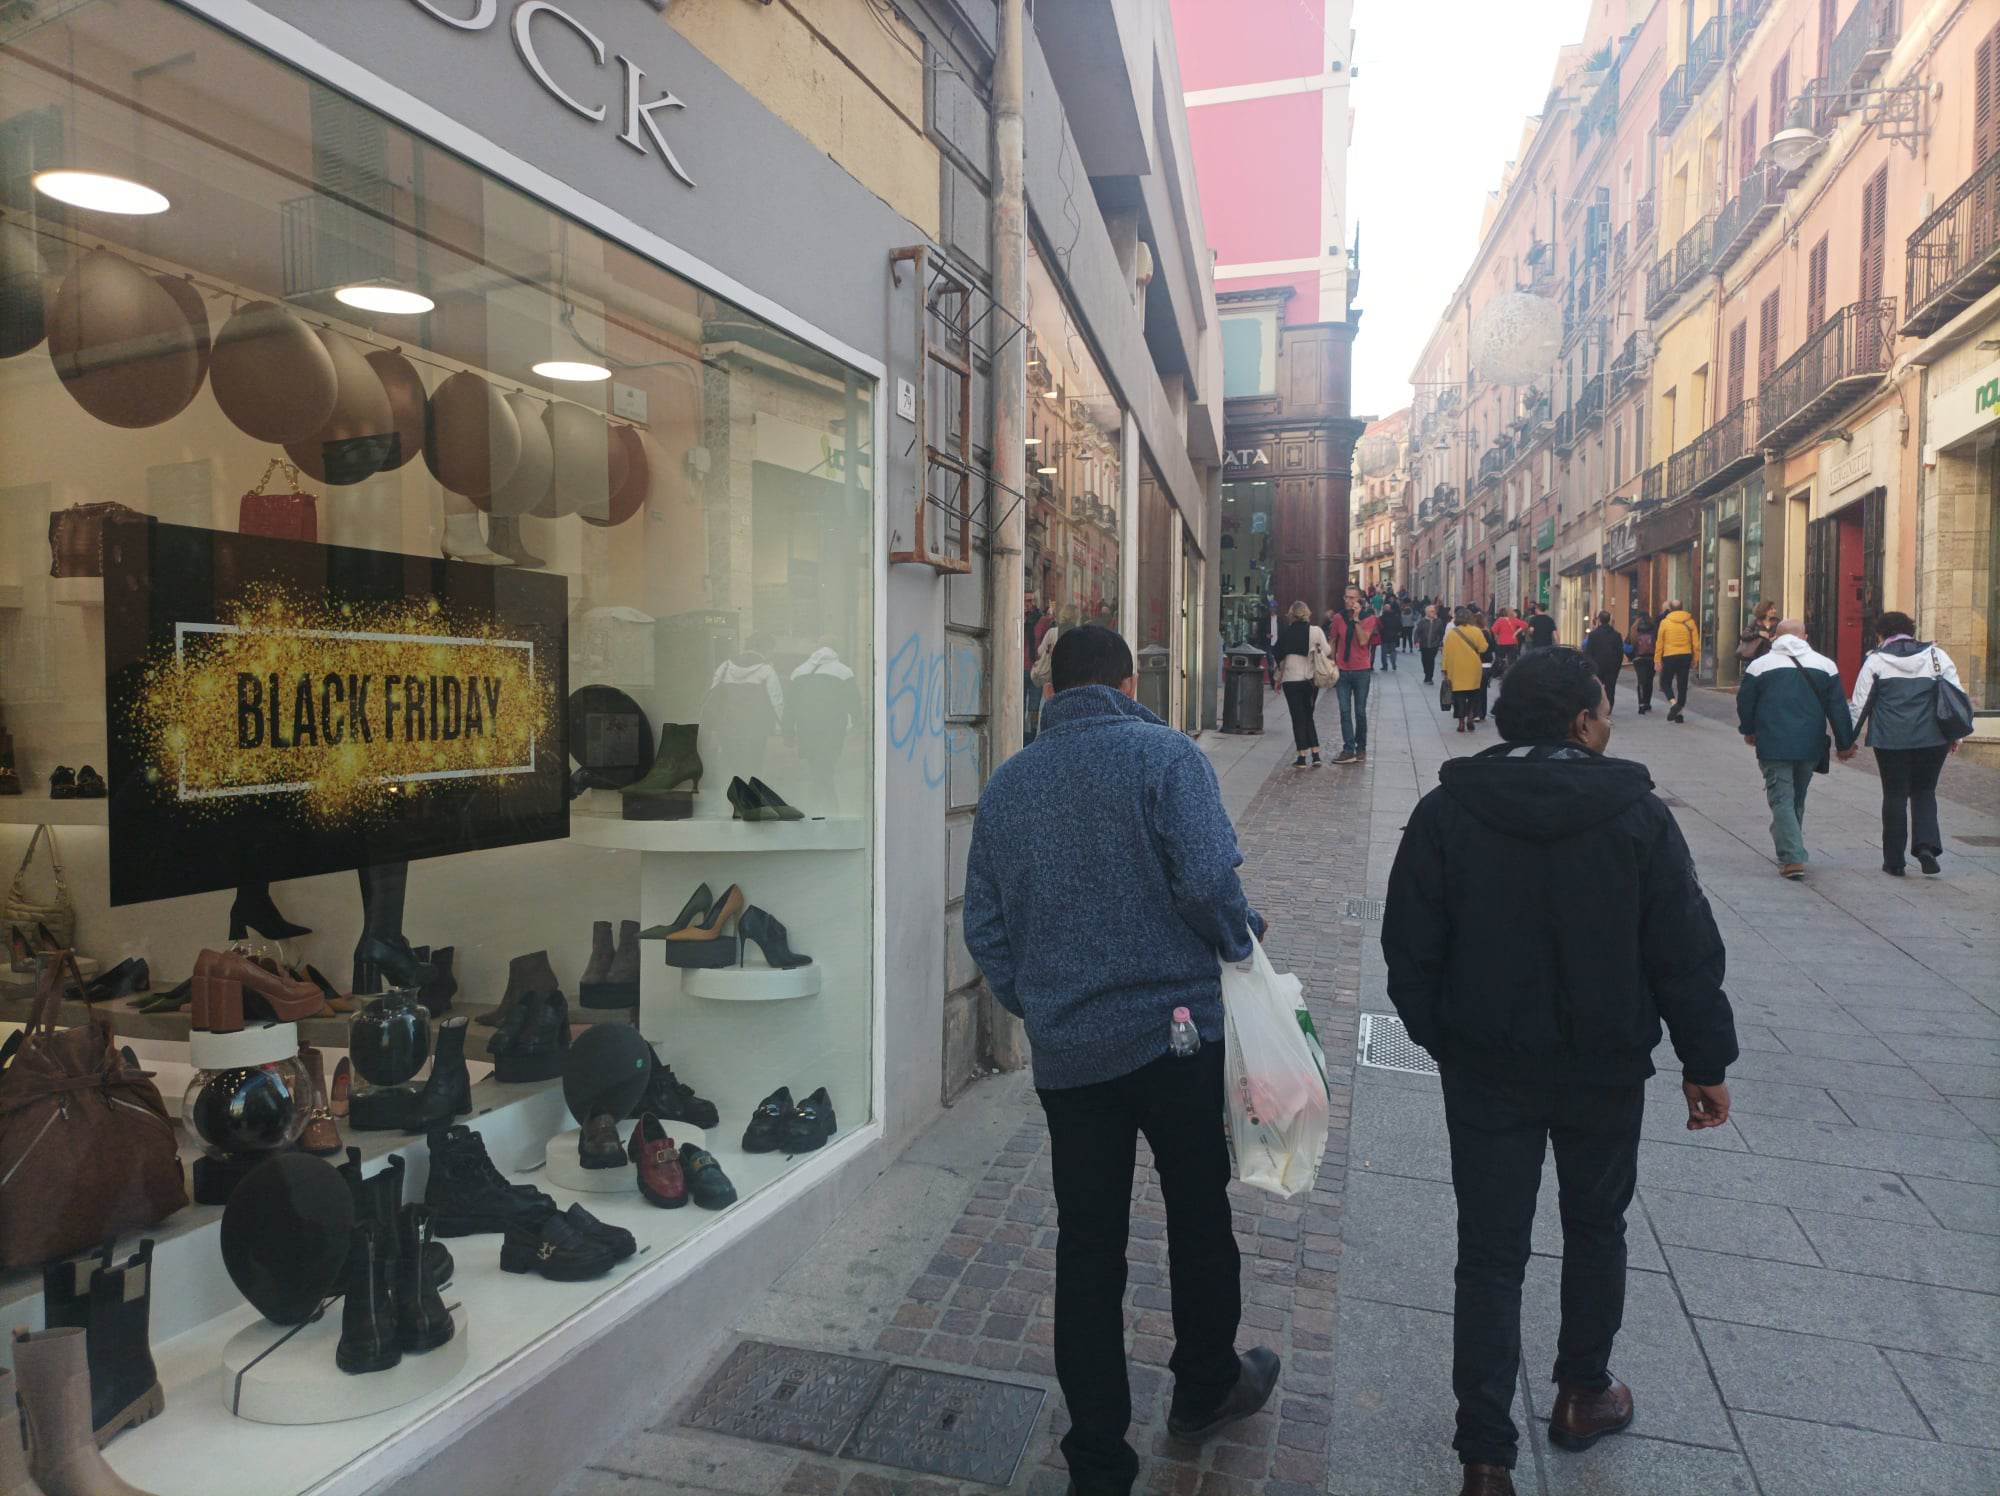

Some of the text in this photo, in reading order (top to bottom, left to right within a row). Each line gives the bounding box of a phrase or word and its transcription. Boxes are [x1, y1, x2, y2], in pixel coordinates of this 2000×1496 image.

[1975, 377, 2000, 414] na
[237, 672, 501, 749] BLACK FRIDAY
